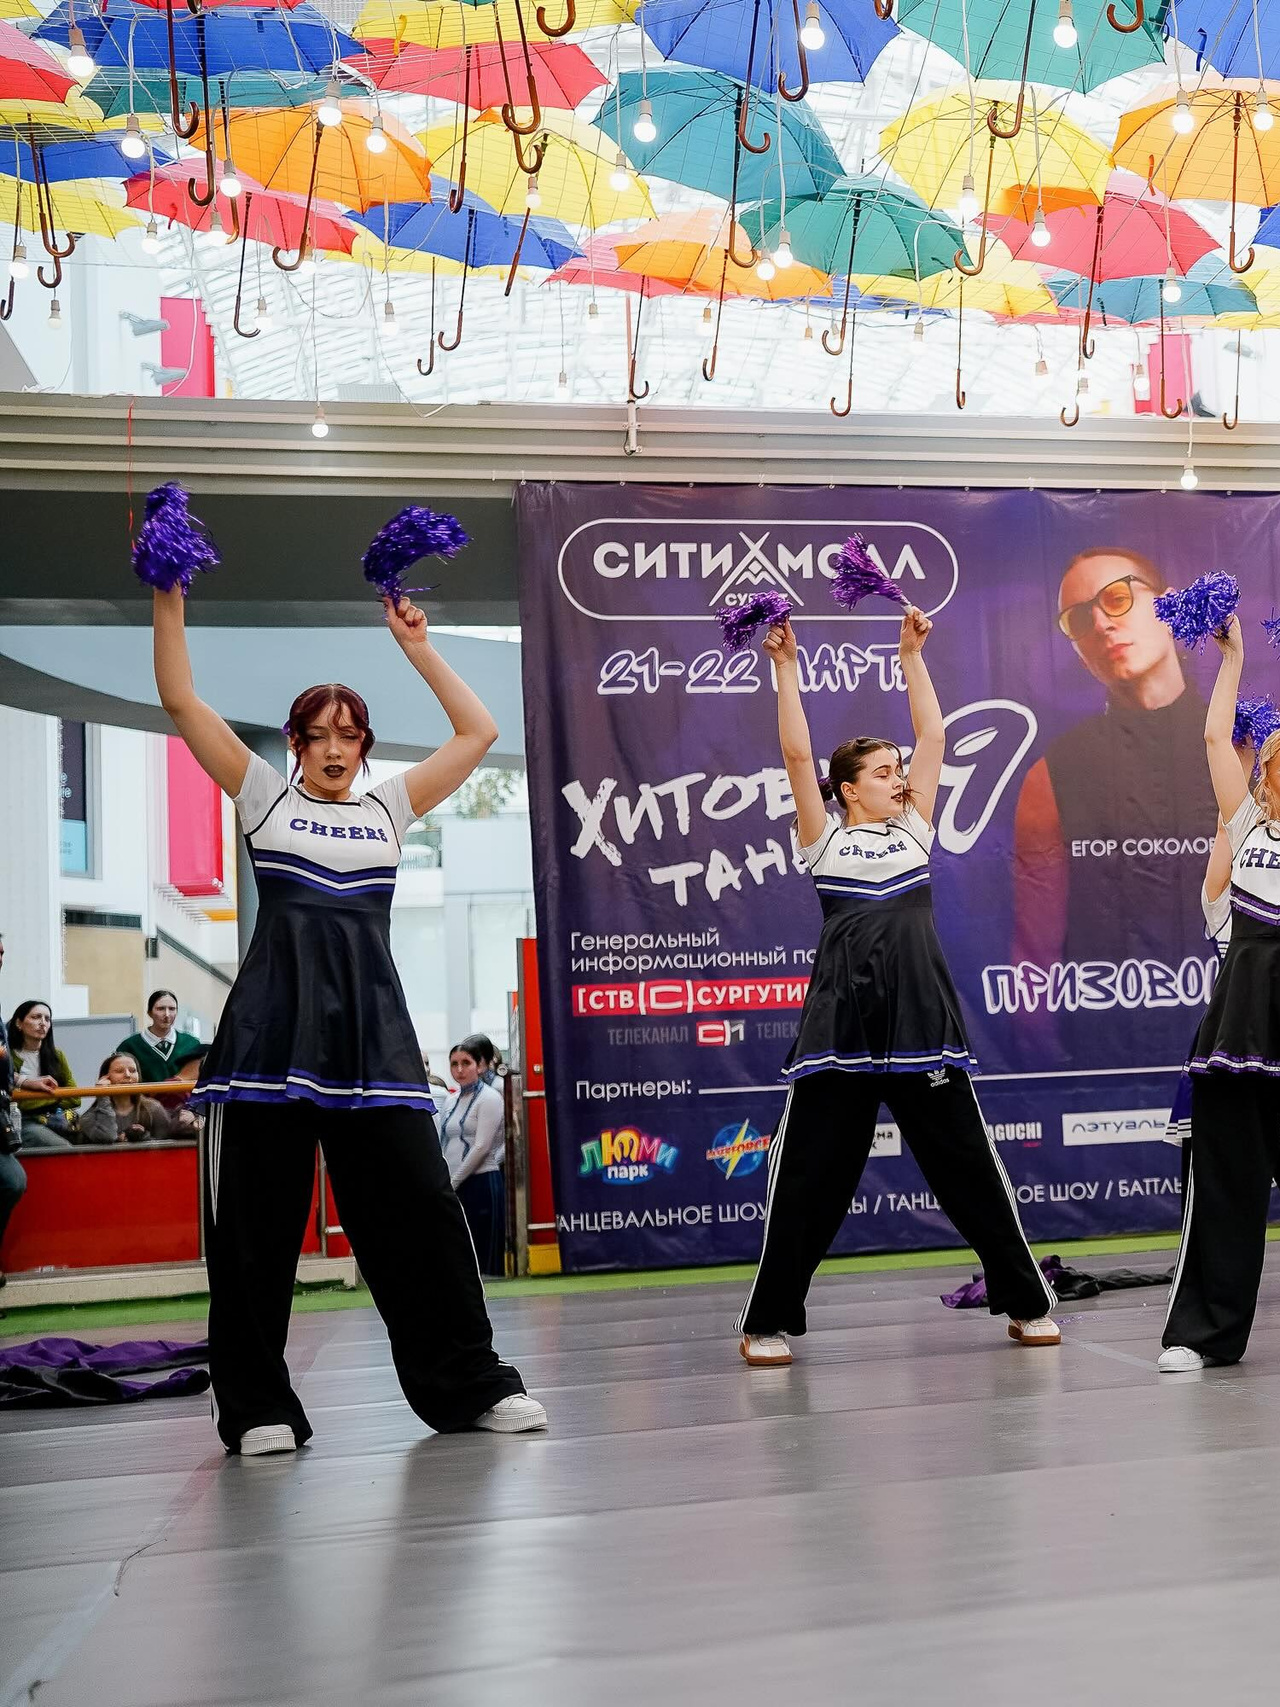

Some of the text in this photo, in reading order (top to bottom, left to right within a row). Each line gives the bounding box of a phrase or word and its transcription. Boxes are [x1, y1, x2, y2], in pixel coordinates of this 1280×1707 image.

[777, 543, 926, 580] МОЛ
[597, 647, 761, 695] 21-22
[289, 818, 389, 843] CHEERS
[1072, 839, 1118, 857] ЕГОР
[571, 926, 720, 953] Генеральный
[571, 945, 787, 975] информационный
[607, 1024, 689, 1046] ТЕЛЕКАНАЛ
[576, 1078, 692, 1102] Партнеры:
[607, 1163, 649, 1181] парк
[556, 1204, 712, 1233] АНЦЕВАЛЬНОЕ
[1050, 1181, 1099, 1202] ШОУ
